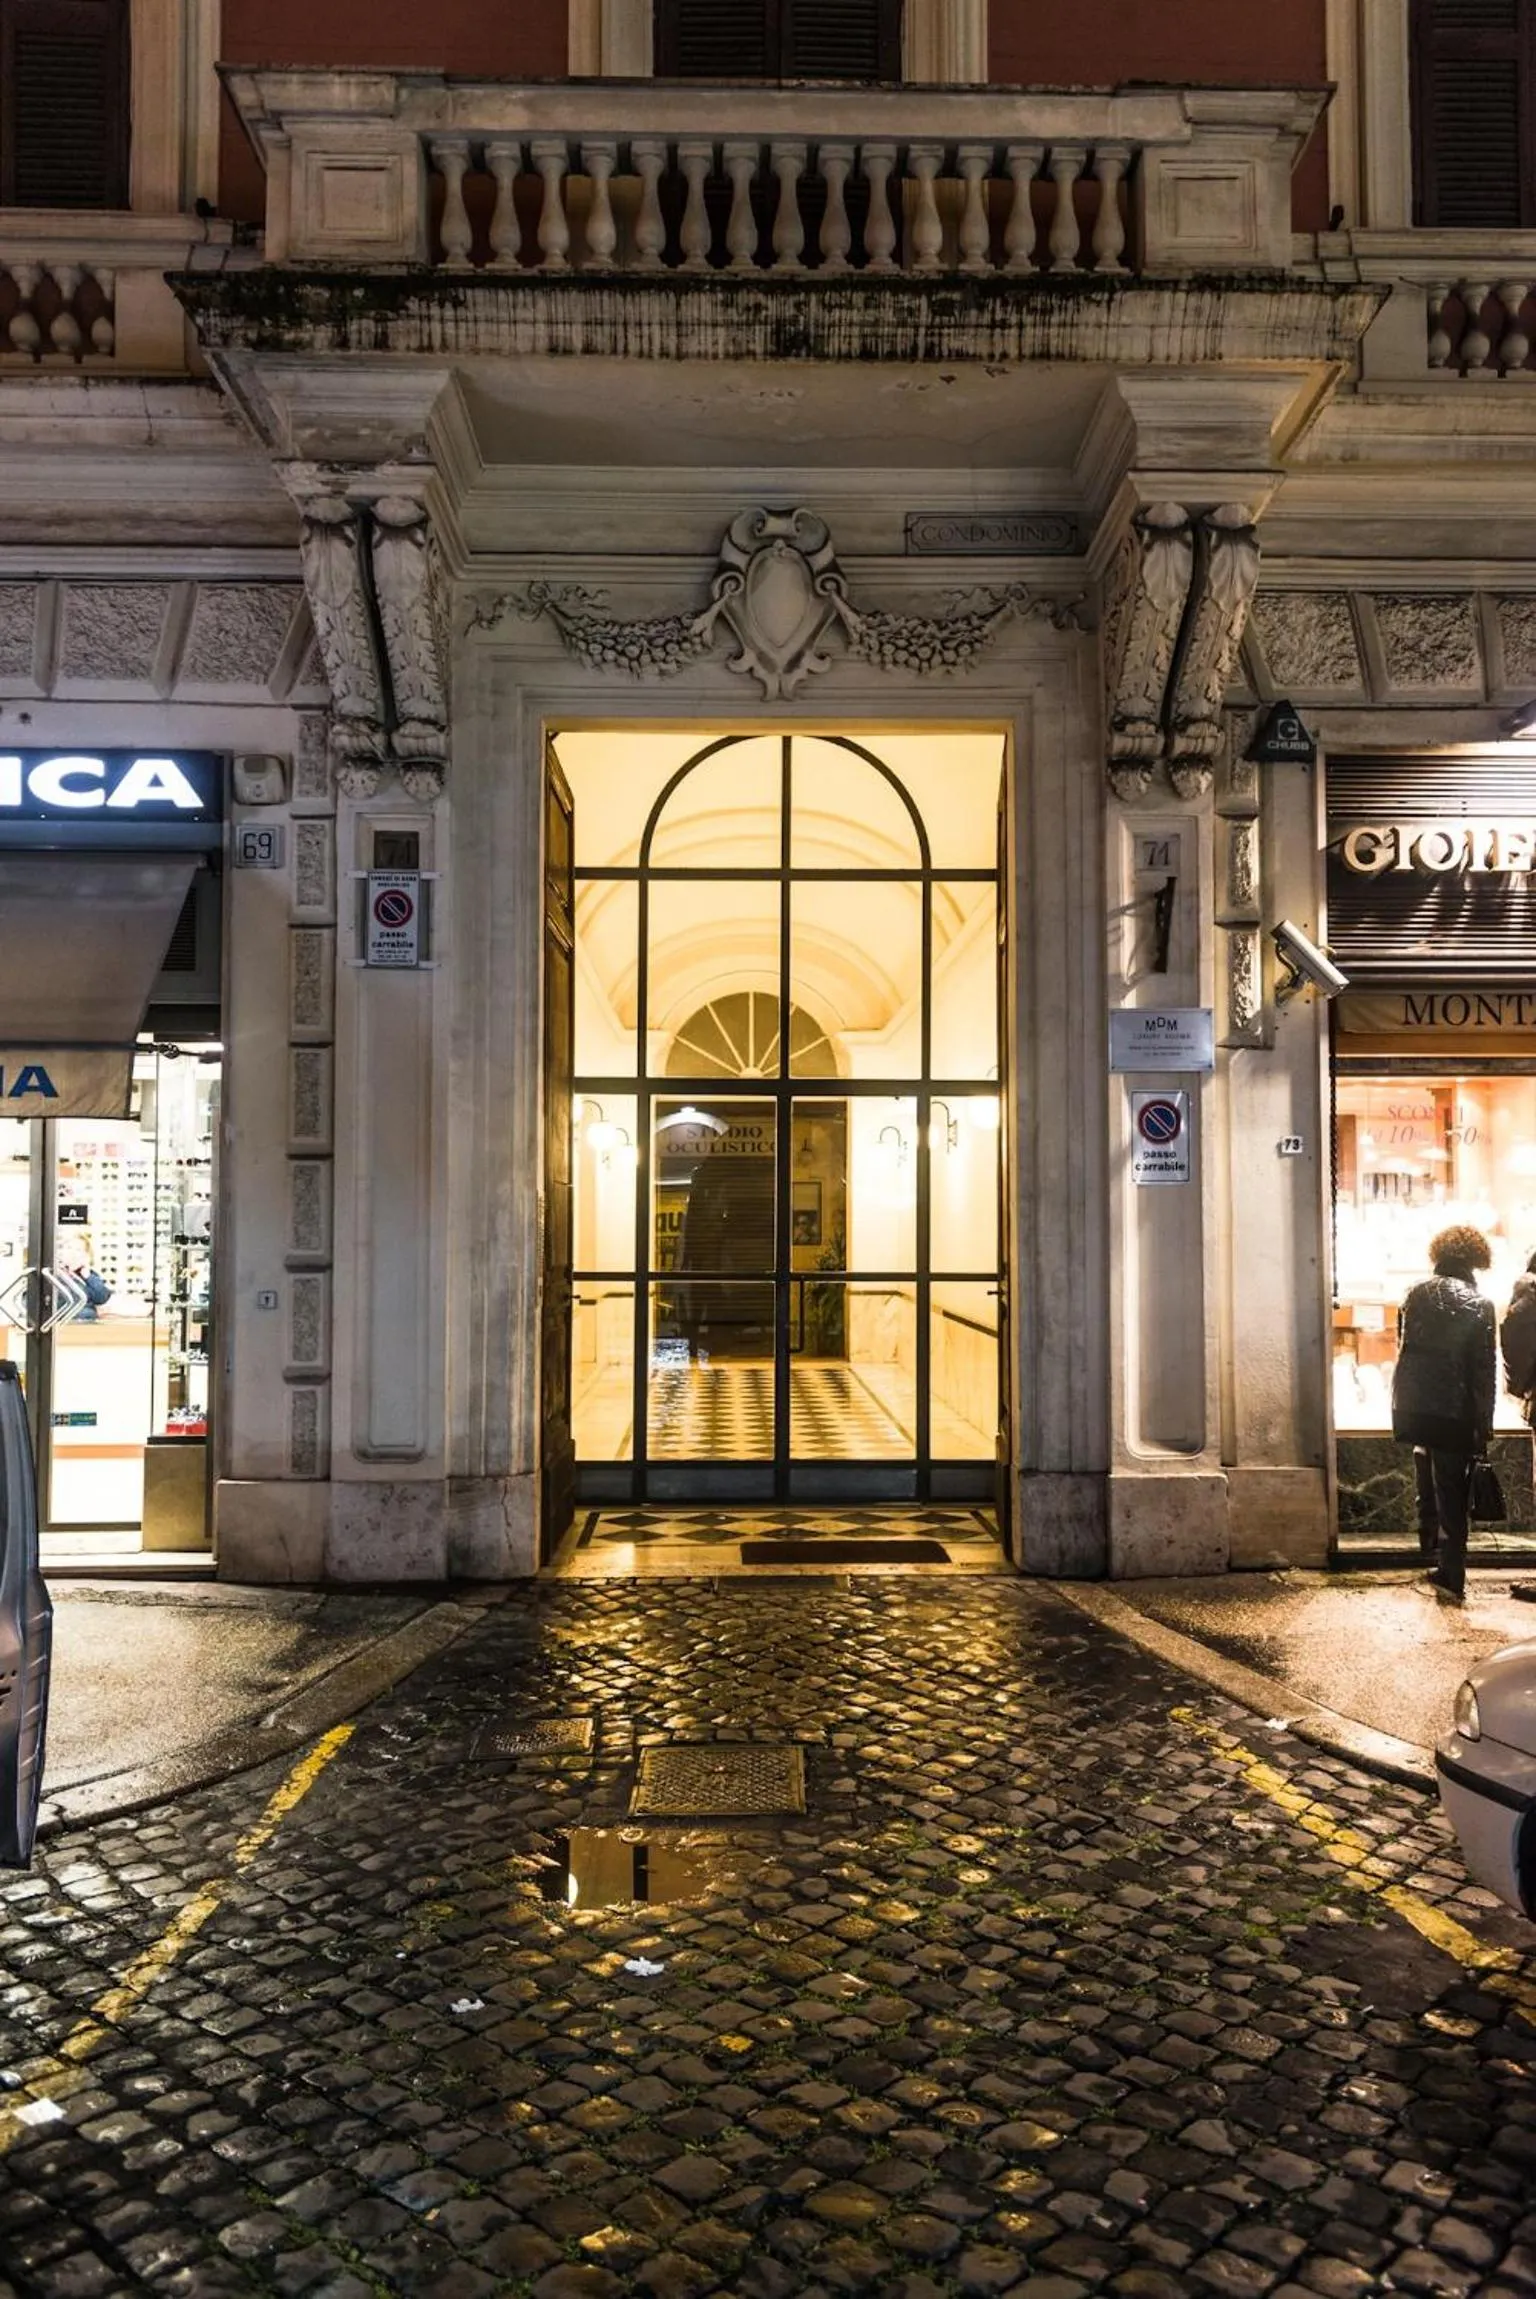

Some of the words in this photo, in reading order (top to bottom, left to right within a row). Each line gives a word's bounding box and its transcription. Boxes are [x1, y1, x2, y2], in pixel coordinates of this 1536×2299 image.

[920, 524, 1065, 543] CONDOMINIO
[1267, 740, 1310, 751] CHUBB
[243, 832, 272, 860] 69
[1142, 841, 1170, 866] 71
[1343, 826, 1536, 873] GIOIE
[379, 932, 407, 940] passo
[371, 940, 414, 949] carrabile
[1402, 994, 1536, 1027] MONT
[1145, 1016, 1178, 1031] MDM
[0, 1065, 60, 1098] A
[1284, 1138, 1300, 1151] 73
[1143, 1150, 1177, 1161] passo
[1135, 1161, 1186, 1172] carrabile
